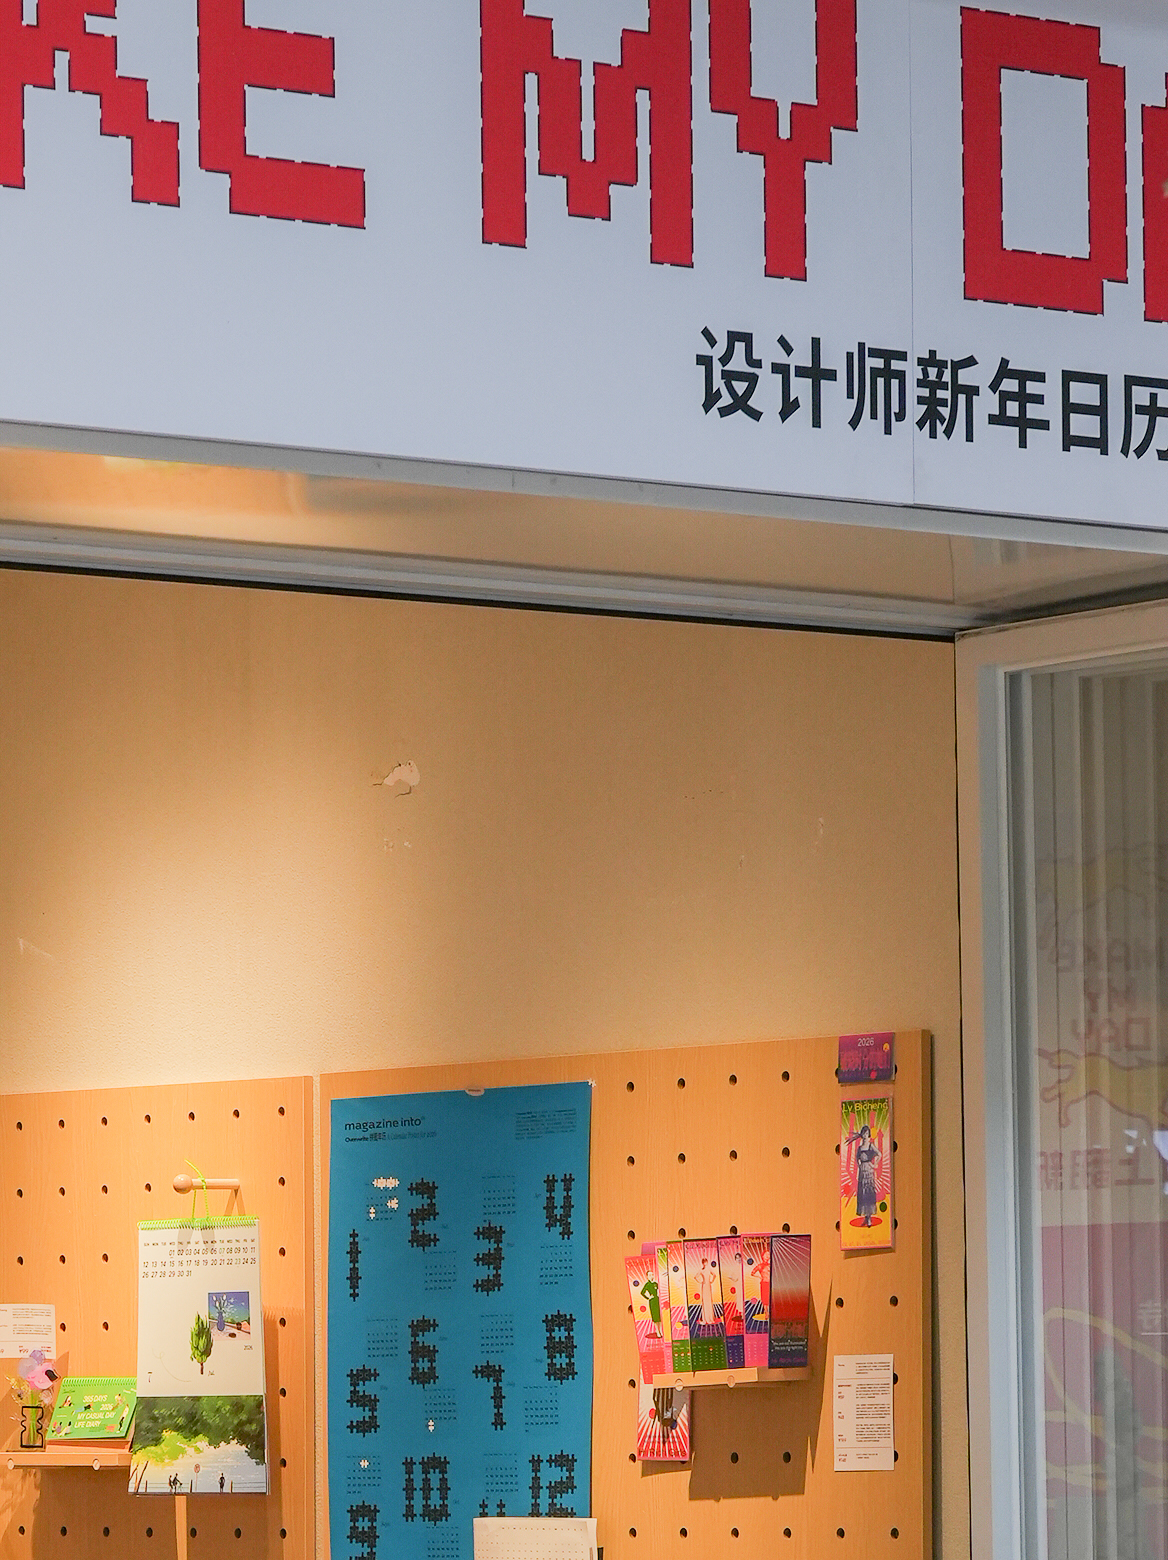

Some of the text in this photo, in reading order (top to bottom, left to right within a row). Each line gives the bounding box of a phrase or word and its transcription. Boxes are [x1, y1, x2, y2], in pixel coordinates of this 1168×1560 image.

[961, 7, 1168, 323] D
[695, 326, 1168, 460] 设计师新年日历
[344, 1118, 399, 1132] magazine
